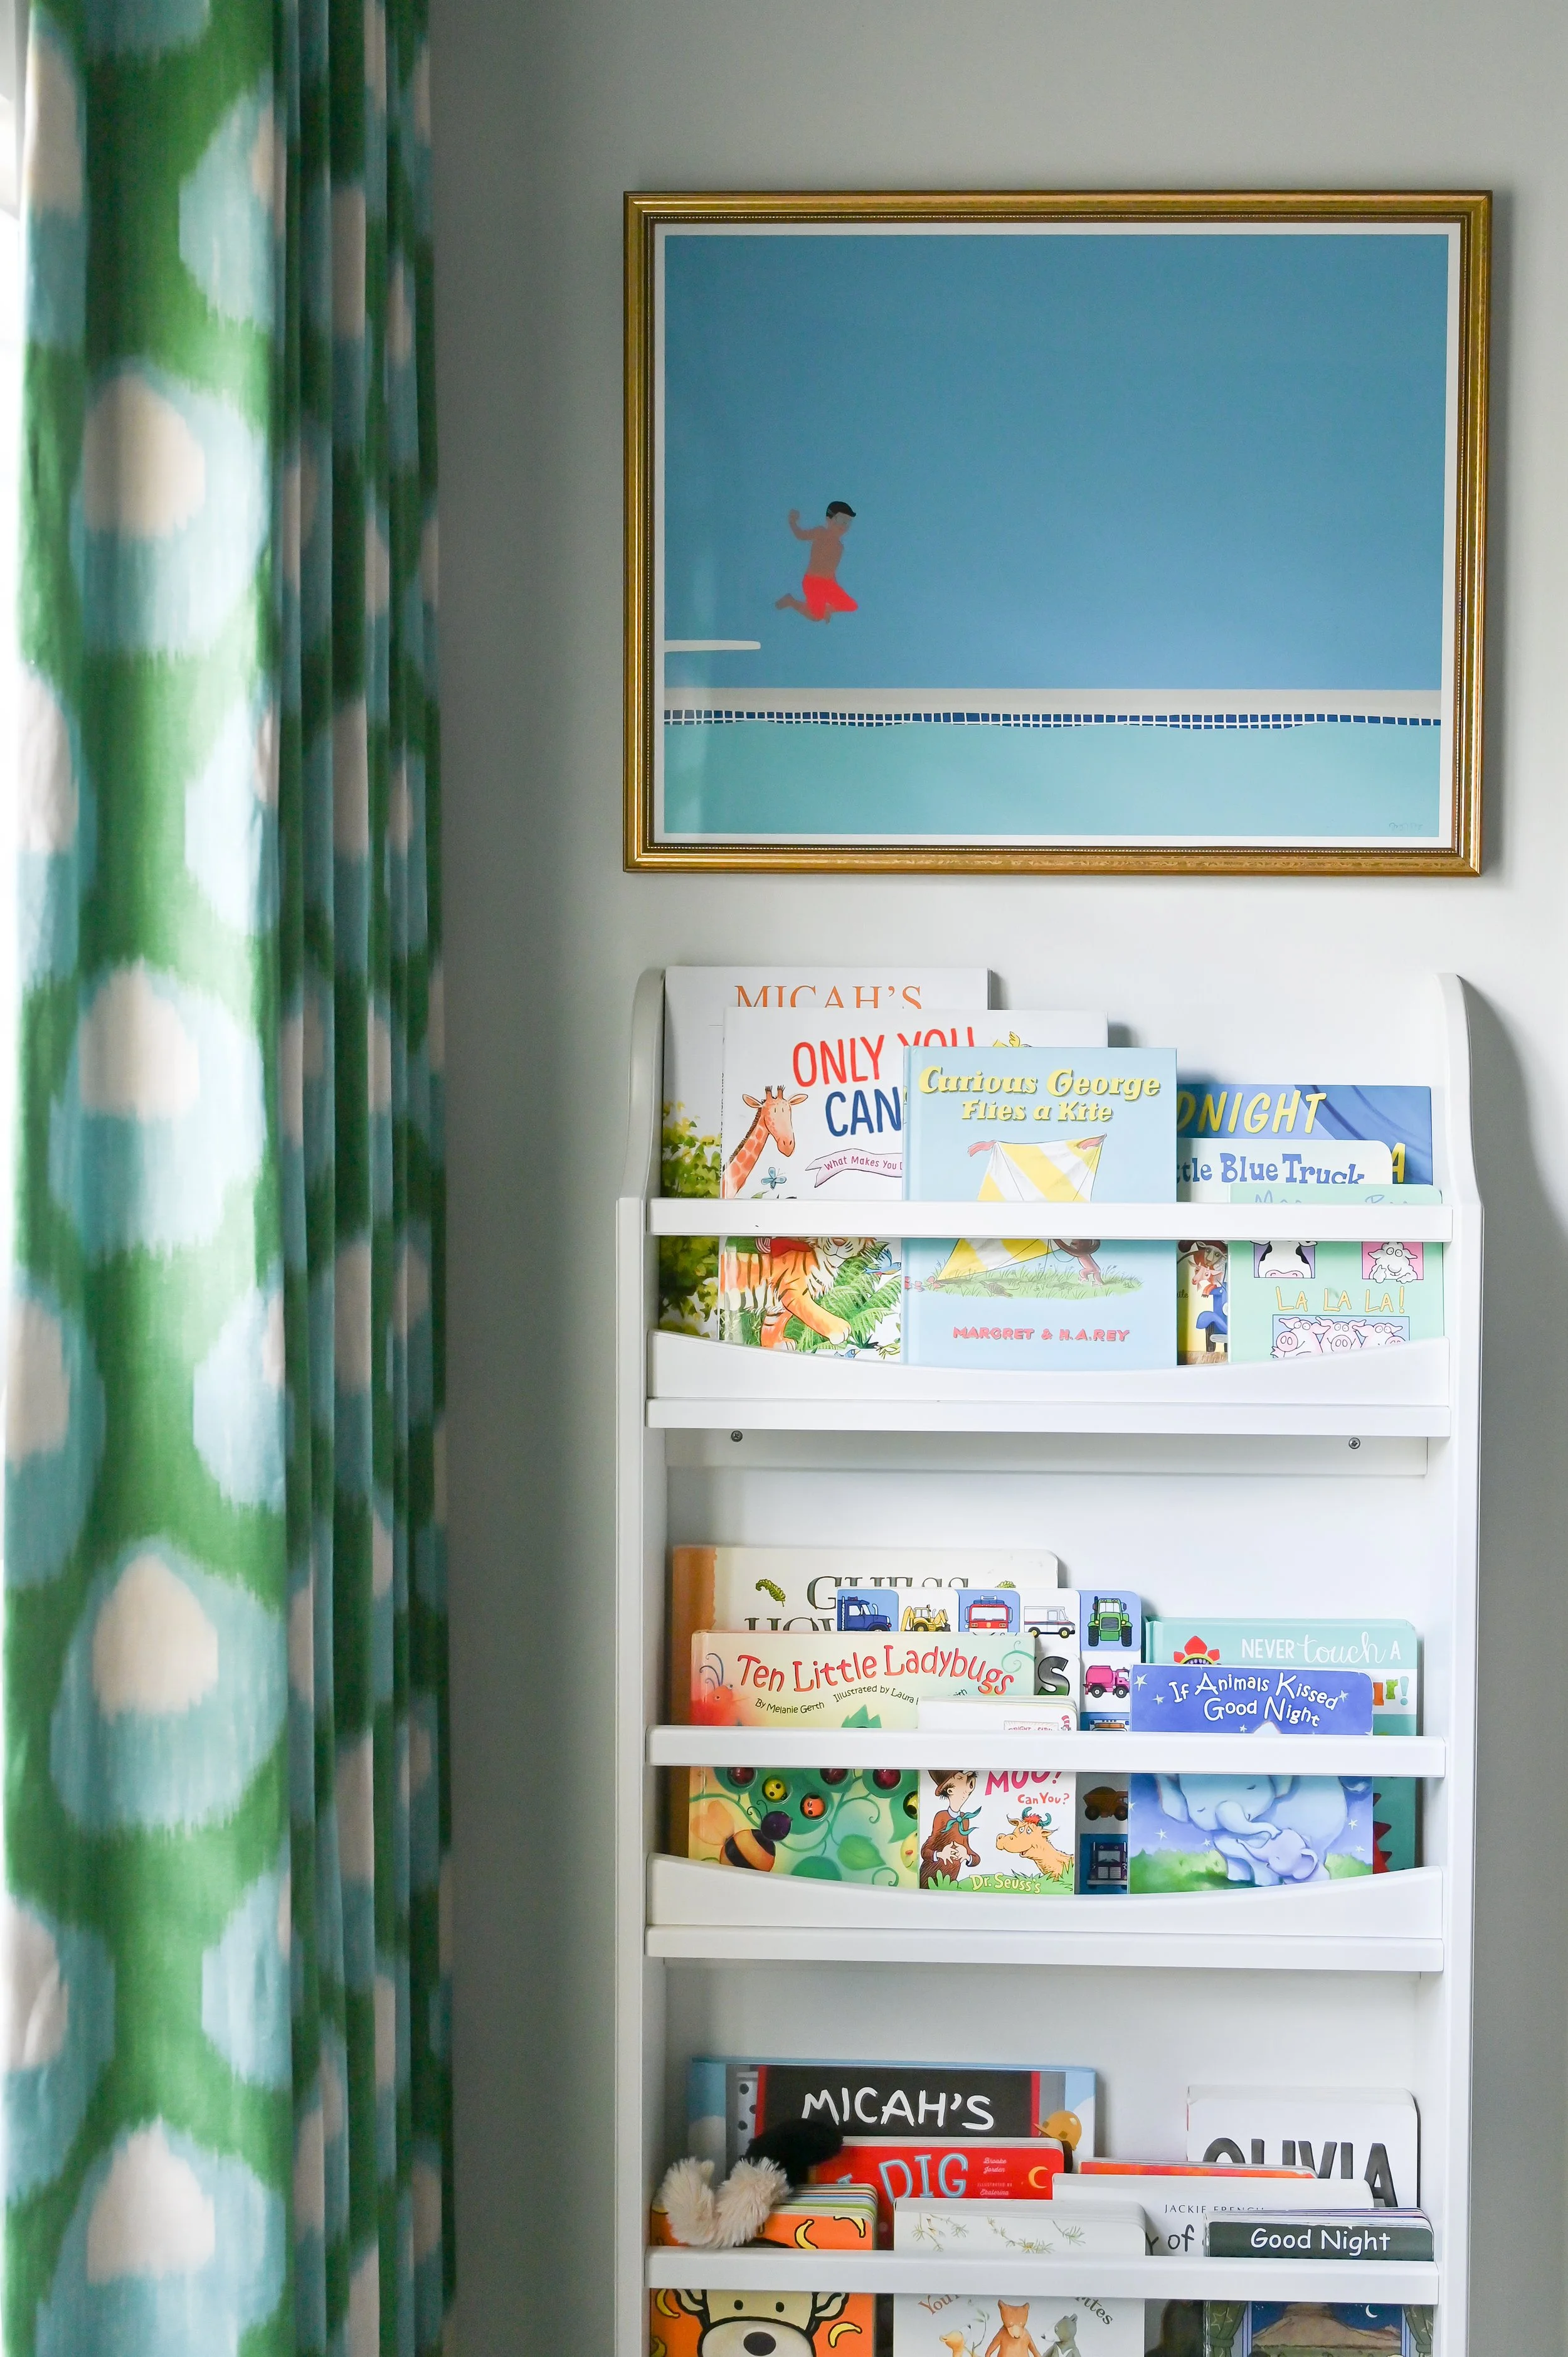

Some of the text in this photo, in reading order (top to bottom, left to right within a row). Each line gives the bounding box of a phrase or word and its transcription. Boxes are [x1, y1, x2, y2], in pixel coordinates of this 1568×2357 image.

[793, 1035, 884, 1088] ONLY
[918, 1065, 1162, 1102] Curious George
[825, 1086, 902, 1137] CAN
[961, 1099, 1114, 1122] Flies a Kite
[1177, 1089, 1327, 1134] DNIGHT
[824, 1156, 848, 1171] What
[851, 1156, 879, 1168] Makes
[883, 1160, 897, 1170] You
[1220, 1152, 1278, 1183] Blue
[1282, 1153, 1365, 1184] Truck
[1276, 1285, 1405, 1314] LA LA LA!
[953, 1326, 1035, 1340] MARGRET
[1041, 1327, 1052, 1340] &
[1241, 1631, 1401, 1664] NEVER touch A
[737, 1654, 785, 1693] Ten
[792, 1652, 877, 1693] Little
[884, 1644, 1015, 1695] Ladybugs
[755, 1698, 766, 1709] By
[766, 1703, 798, 1714] Melanie
[800, 1701, 825, 1714] Gerth
[833, 1684, 877, 1703] Illustrated
[879, 1685, 891, 1695] by
[891, 1688, 914, 1705] Laura
[1168, 1671, 1340, 1711] If Animals Kissed
[1204, 1696, 1321, 1728] Good Night
[1017, 1792, 1070, 1805] Can You?
[970, 1872, 1041, 1894] Dr. Seuss's
[801, 2086, 995, 2131] MICAH'S
[878, 2152, 969, 2204] DIG
[1165, 2204, 1207, 2213] JACKIE
[1167, 2224, 1195, 2252] of
[1250, 2227, 1392, 2257] Good Night
[918, 2294, 960, 2315] You
